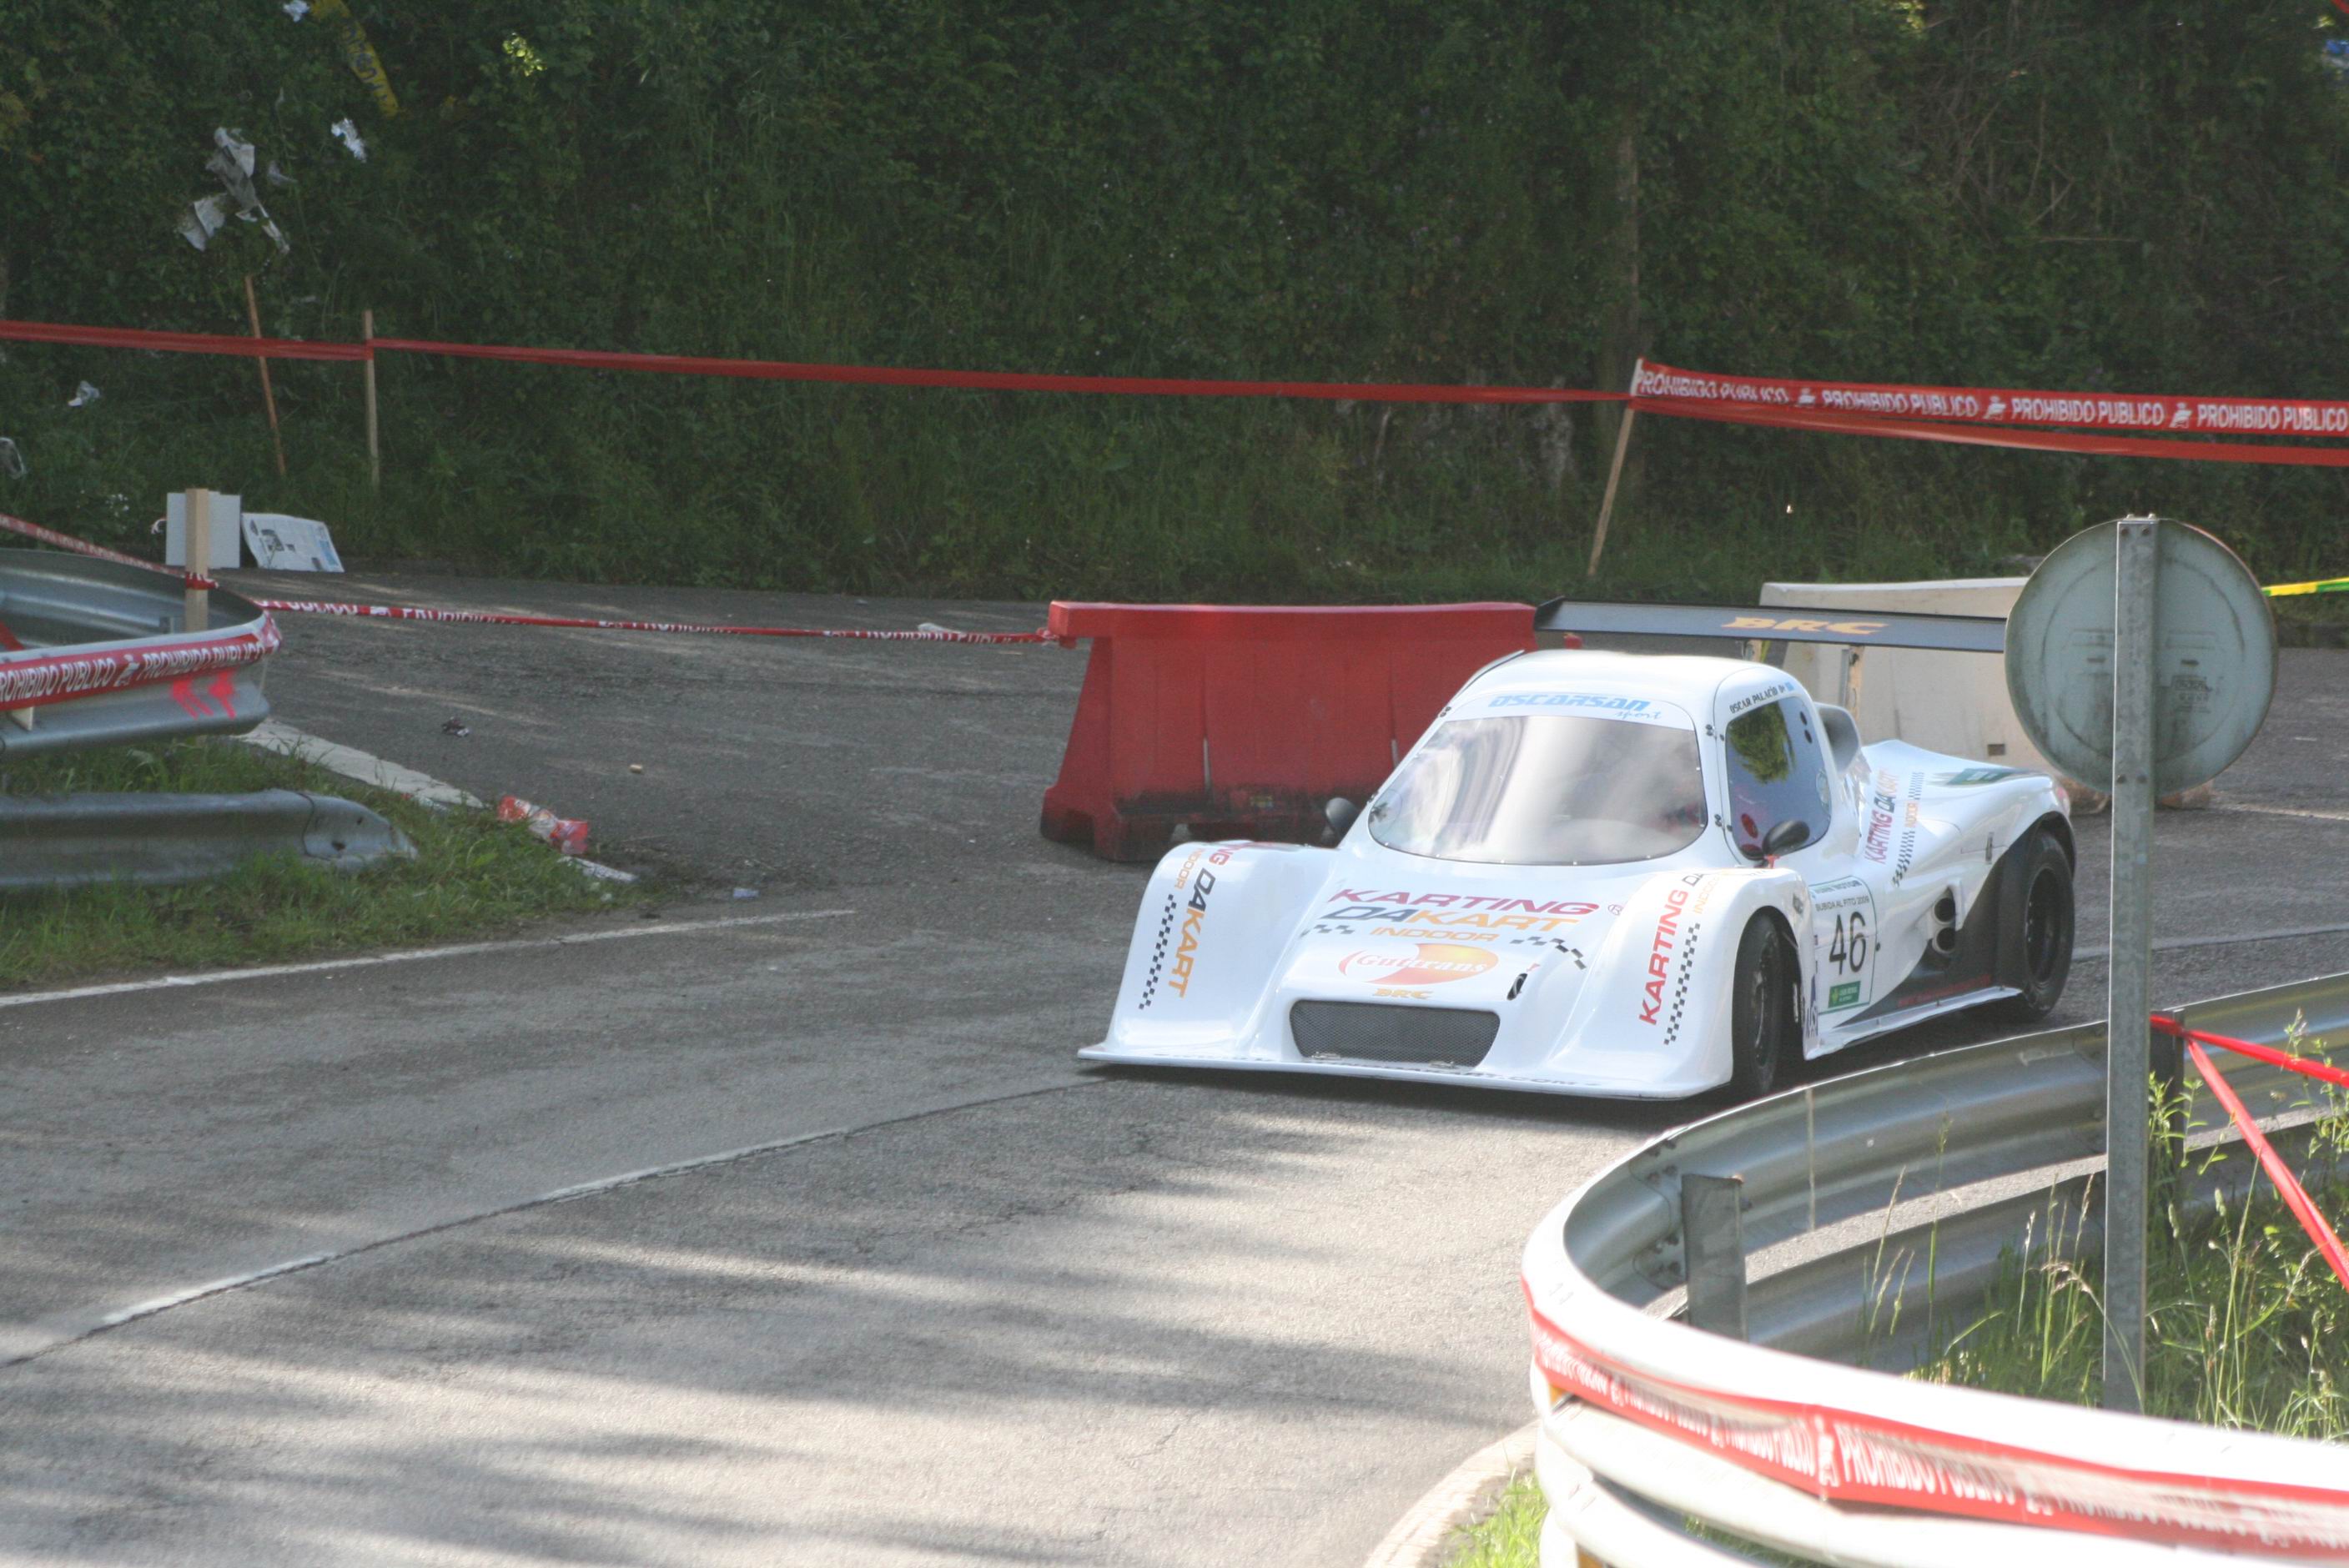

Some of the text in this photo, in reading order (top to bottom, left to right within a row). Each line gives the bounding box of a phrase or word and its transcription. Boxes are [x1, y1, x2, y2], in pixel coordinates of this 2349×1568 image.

[1822, 389, 1909, 413] PROHIBIDO
[1909, 395, 1979, 417] PUBLICO
[2011, 397, 2095, 423] PROHIBIDO
[2098, 400, 2165, 426] PUBLICO
[2197, 404, 2280, 430] PROHIBIDO
[2282, 406, 2348, 432] PUBLICO
[1722, 616, 1888, 635] BRC
[0, 665, 59, 702] ROHIBIDO
[57, 658, 117, 694] PUBLICO
[136, 646, 210, 681] PROHIBIDO
[1864, 809, 1893, 866] KARTING
[1320, 906, 1582, 932] DAKART
[1328, 888, 1600, 916] KARTING
[1169, 867, 1216, 998] DAKART
[1370, 927, 1501, 942] INDOOR
[1828, 911, 1867, 976] 46
[1638, 889, 1689, 1026] KARTING
